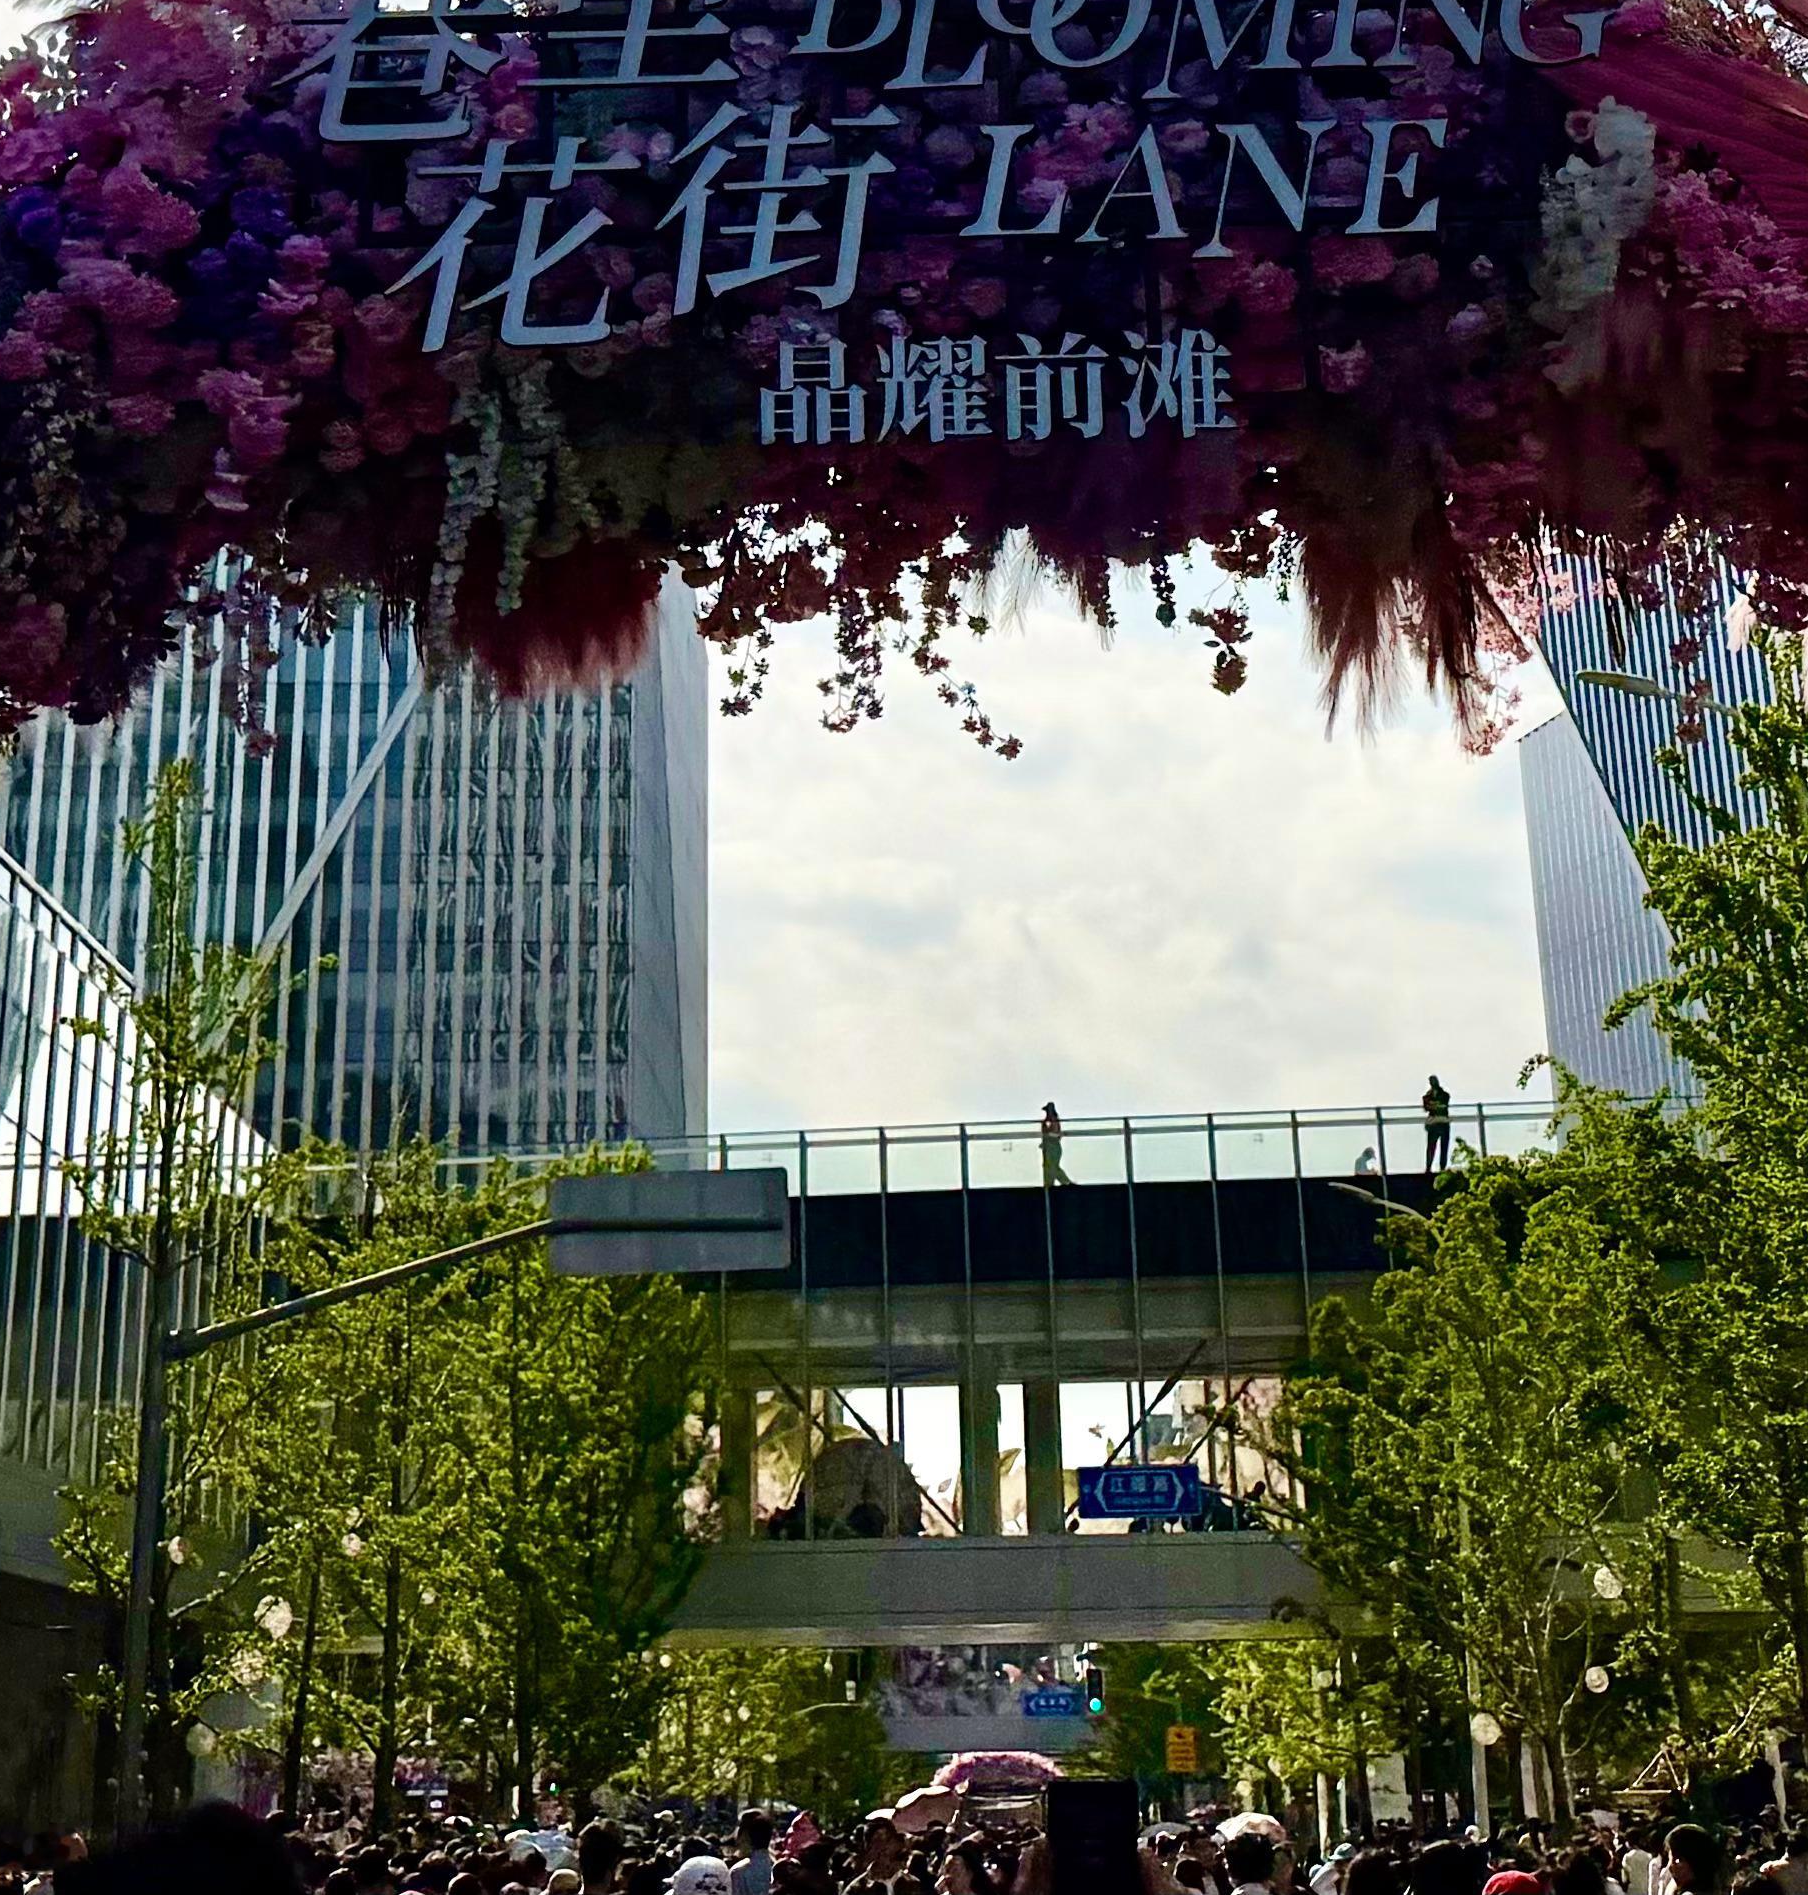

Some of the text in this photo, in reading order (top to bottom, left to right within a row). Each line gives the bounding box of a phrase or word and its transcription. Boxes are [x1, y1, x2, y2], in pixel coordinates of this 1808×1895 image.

[384, 101, 899, 353] 花街
[958, 117, 1448, 260] LANE
[758, 327, 1239, 447] 晶耀前滩
